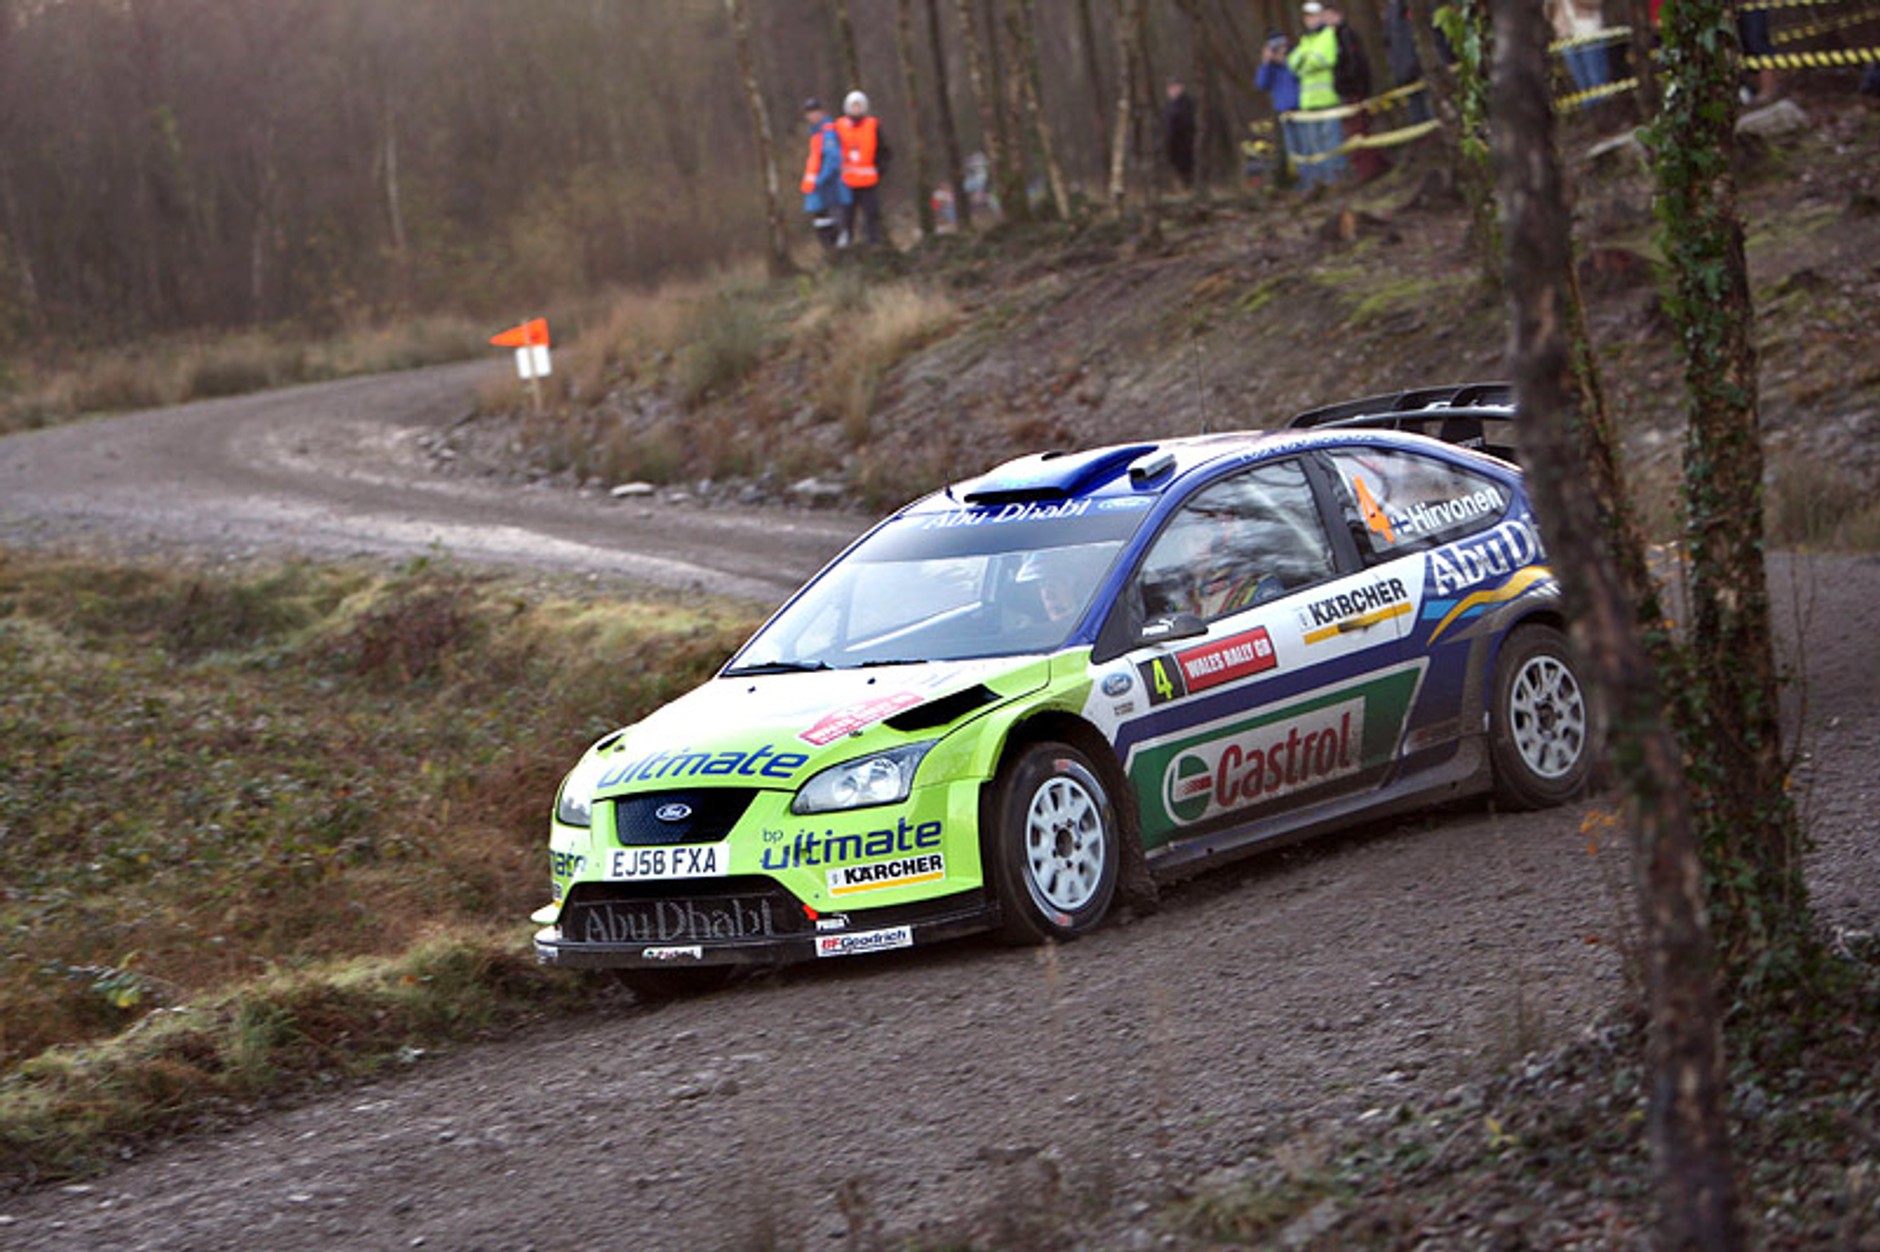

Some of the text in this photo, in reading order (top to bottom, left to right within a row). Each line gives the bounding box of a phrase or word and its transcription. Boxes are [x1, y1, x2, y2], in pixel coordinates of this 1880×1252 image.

[1354, 476, 1395, 543] 4
[1407, 486, 1505, 533] Hirvonen
[1151, 658, 1174, 700] 4
[1184, 652, 1225, 679] WALES
[1222, 642, 1255, 668] RALLY
[597, 744, 810, 789] ultimate
[1216, 711, 1351, 808] Castrol
[672, 846, 717, 875] FXA
[761, 817, 942, 870] ultimate
[821, 930, 907, 950] BFGoodrich
